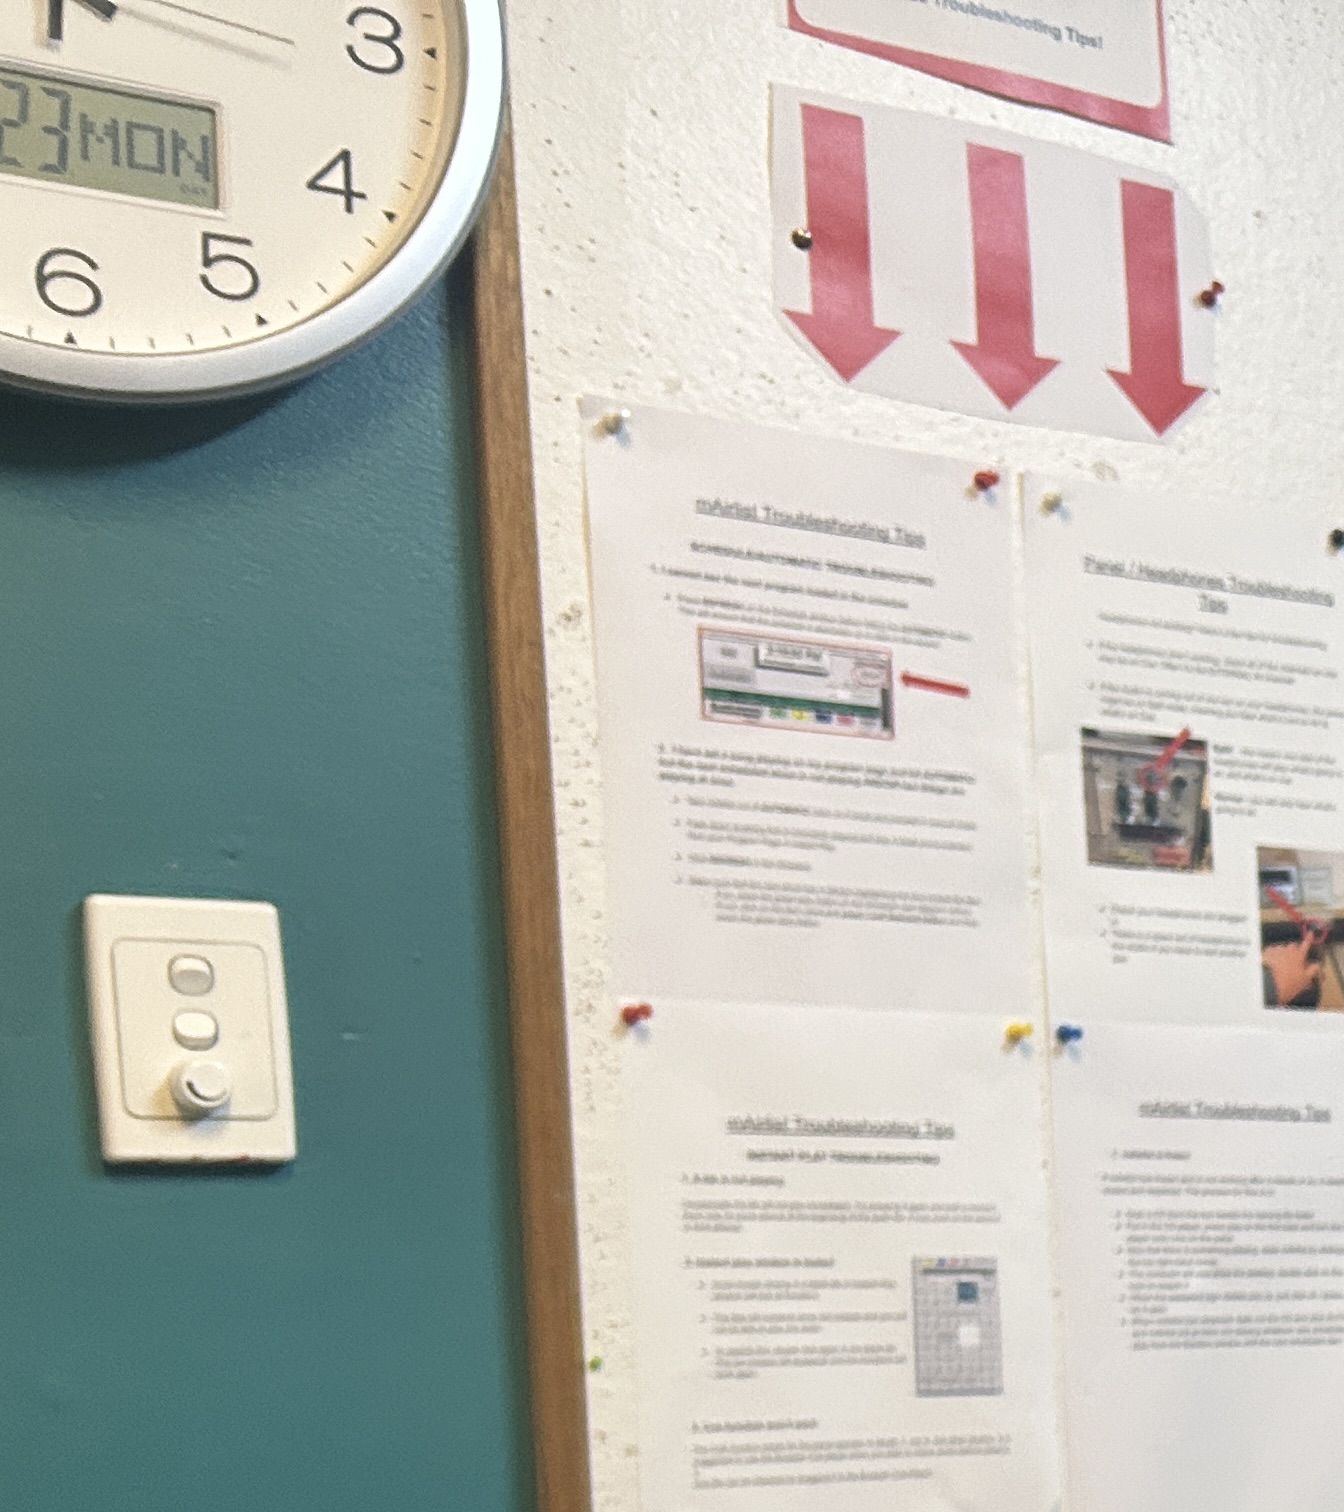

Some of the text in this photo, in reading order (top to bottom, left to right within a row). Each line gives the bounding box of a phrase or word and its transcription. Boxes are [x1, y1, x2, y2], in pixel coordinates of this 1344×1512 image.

[346, 6, 404, 74] 3
[79, 111, 210, 182] MON
[306, 150, 367, 213] 4
[35, 247, 102, 317] 6
[200, 231, 259, 301] 5
